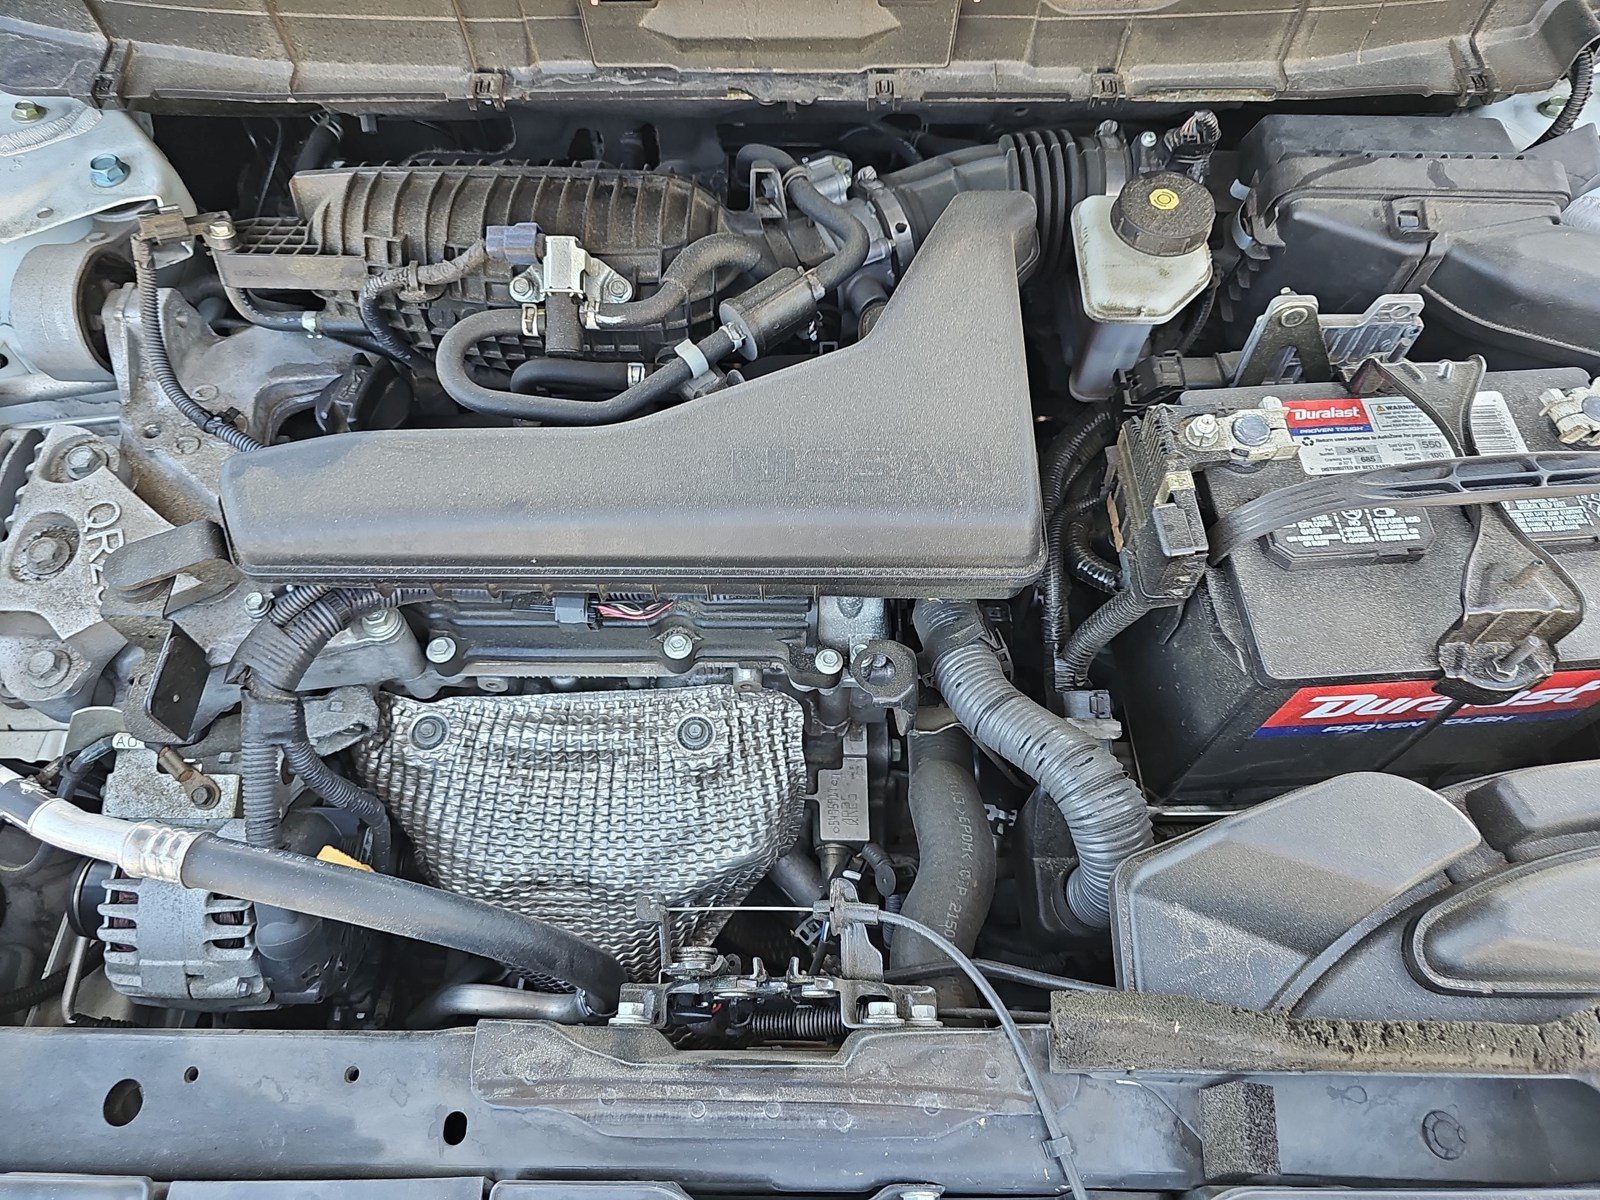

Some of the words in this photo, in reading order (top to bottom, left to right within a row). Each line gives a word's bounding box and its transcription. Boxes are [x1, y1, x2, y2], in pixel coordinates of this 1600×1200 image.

[1290, 406, 1361, 421] Duralast
[1336, 425, 1364, 433] TOUGH
[1422, 441, 1442, 449] 550
[1360, 455, 1377, 463] 685
[83, 500, 125, 606] QR
[1322, 720, 1427, 733] PROVEN
[1443, 715, 1517, 726] OUGH
[840, 793, 859, 827] QR25
